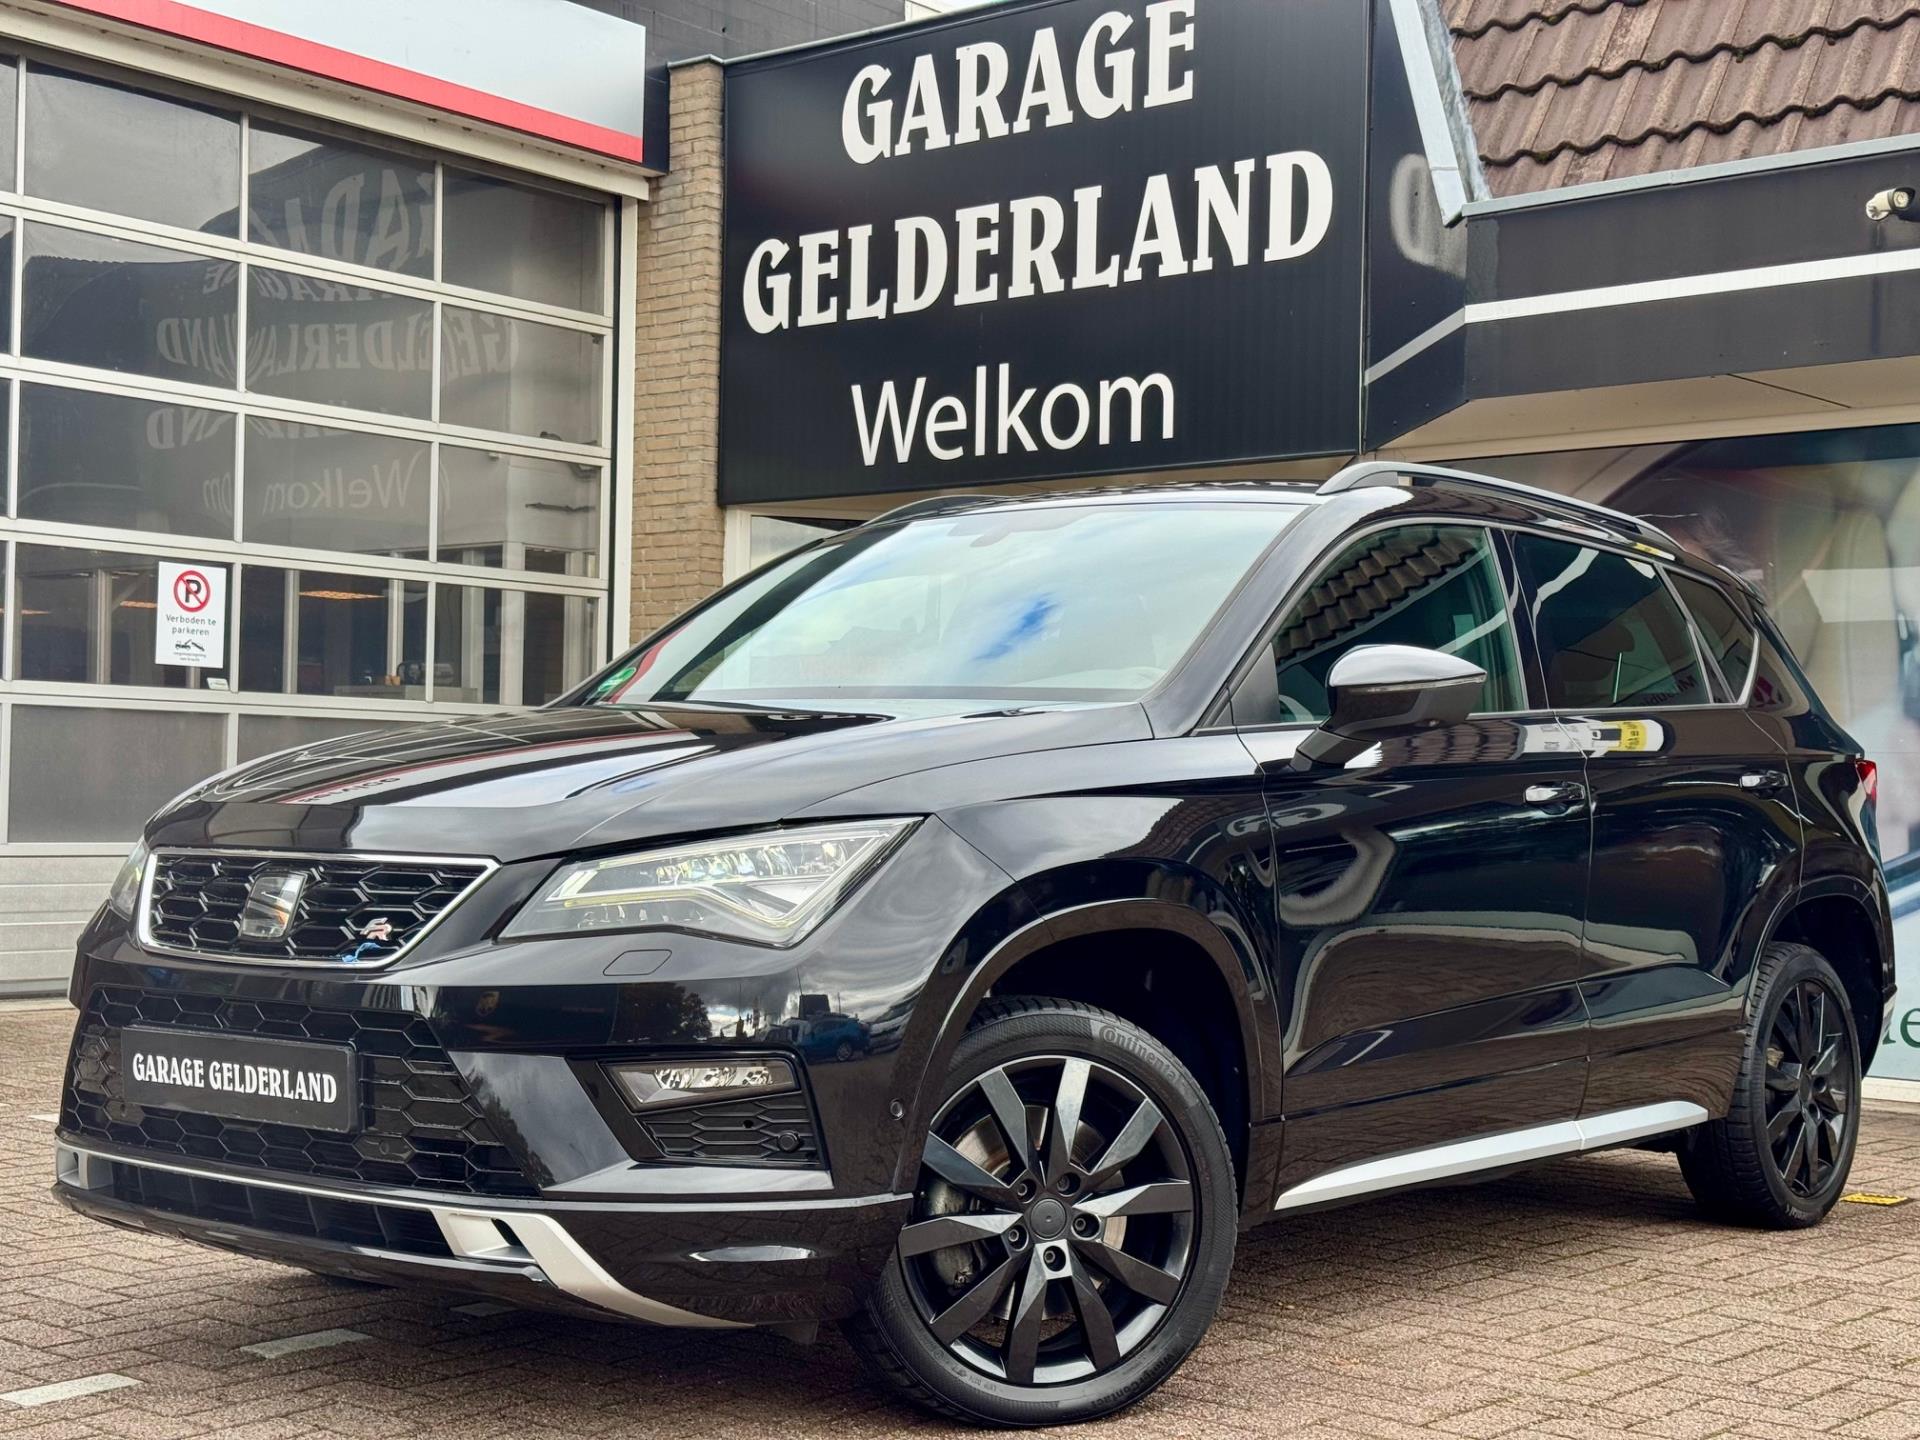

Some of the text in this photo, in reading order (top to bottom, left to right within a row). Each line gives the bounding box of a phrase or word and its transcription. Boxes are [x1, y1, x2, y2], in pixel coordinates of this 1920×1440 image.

[841, 0, 1196, 165] GARAGE
[742, 149, 1334, 334] GELDERLAND
[850, 362, 1176, 467] Welkom
[165, 614, 217, 627] Verboden te
[171, 626, 210, 637] parkeren
[132, 1053, 338, 1104] GARAGE GELDERLAND
